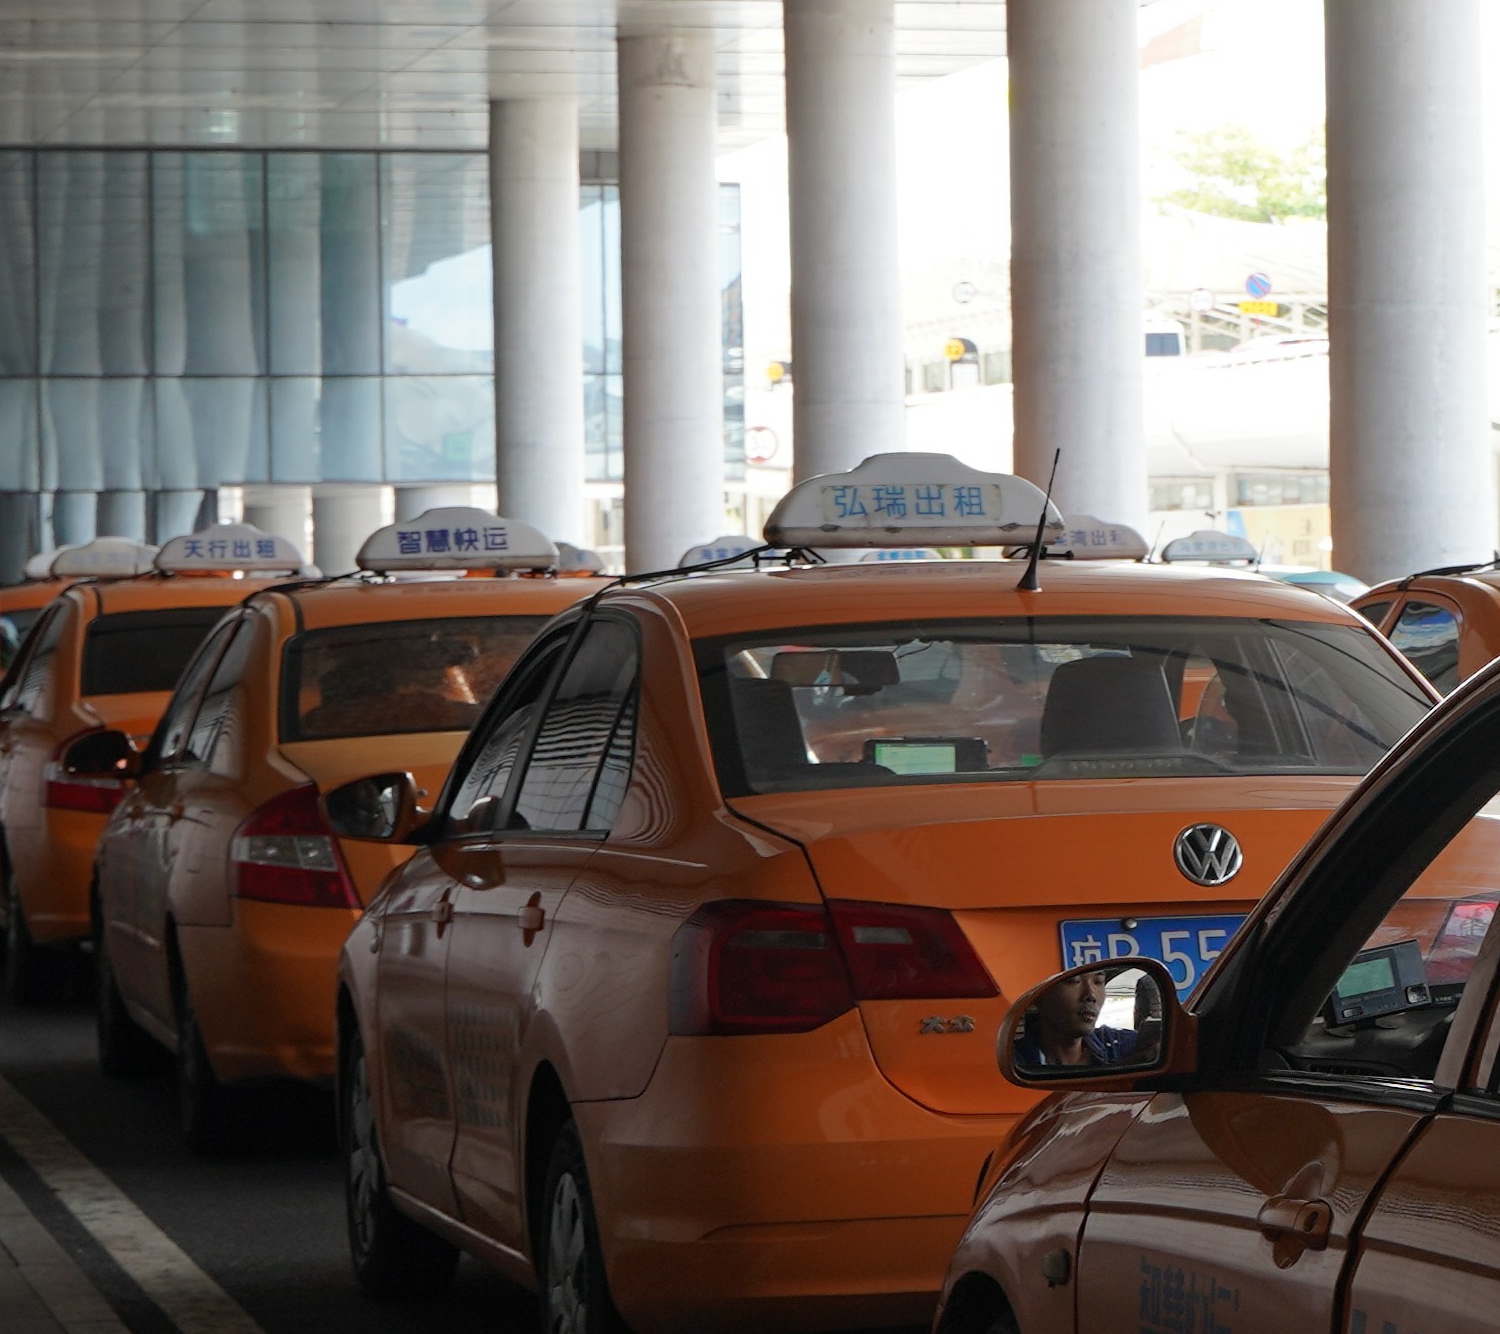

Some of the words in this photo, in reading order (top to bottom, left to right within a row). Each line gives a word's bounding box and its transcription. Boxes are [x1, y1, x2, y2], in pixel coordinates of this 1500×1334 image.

[834, 485, 987, 518] 弘瑞出租
[184, 539, 276, 559] 天行出租
[397, 526, 509, 555] 智慧快运
